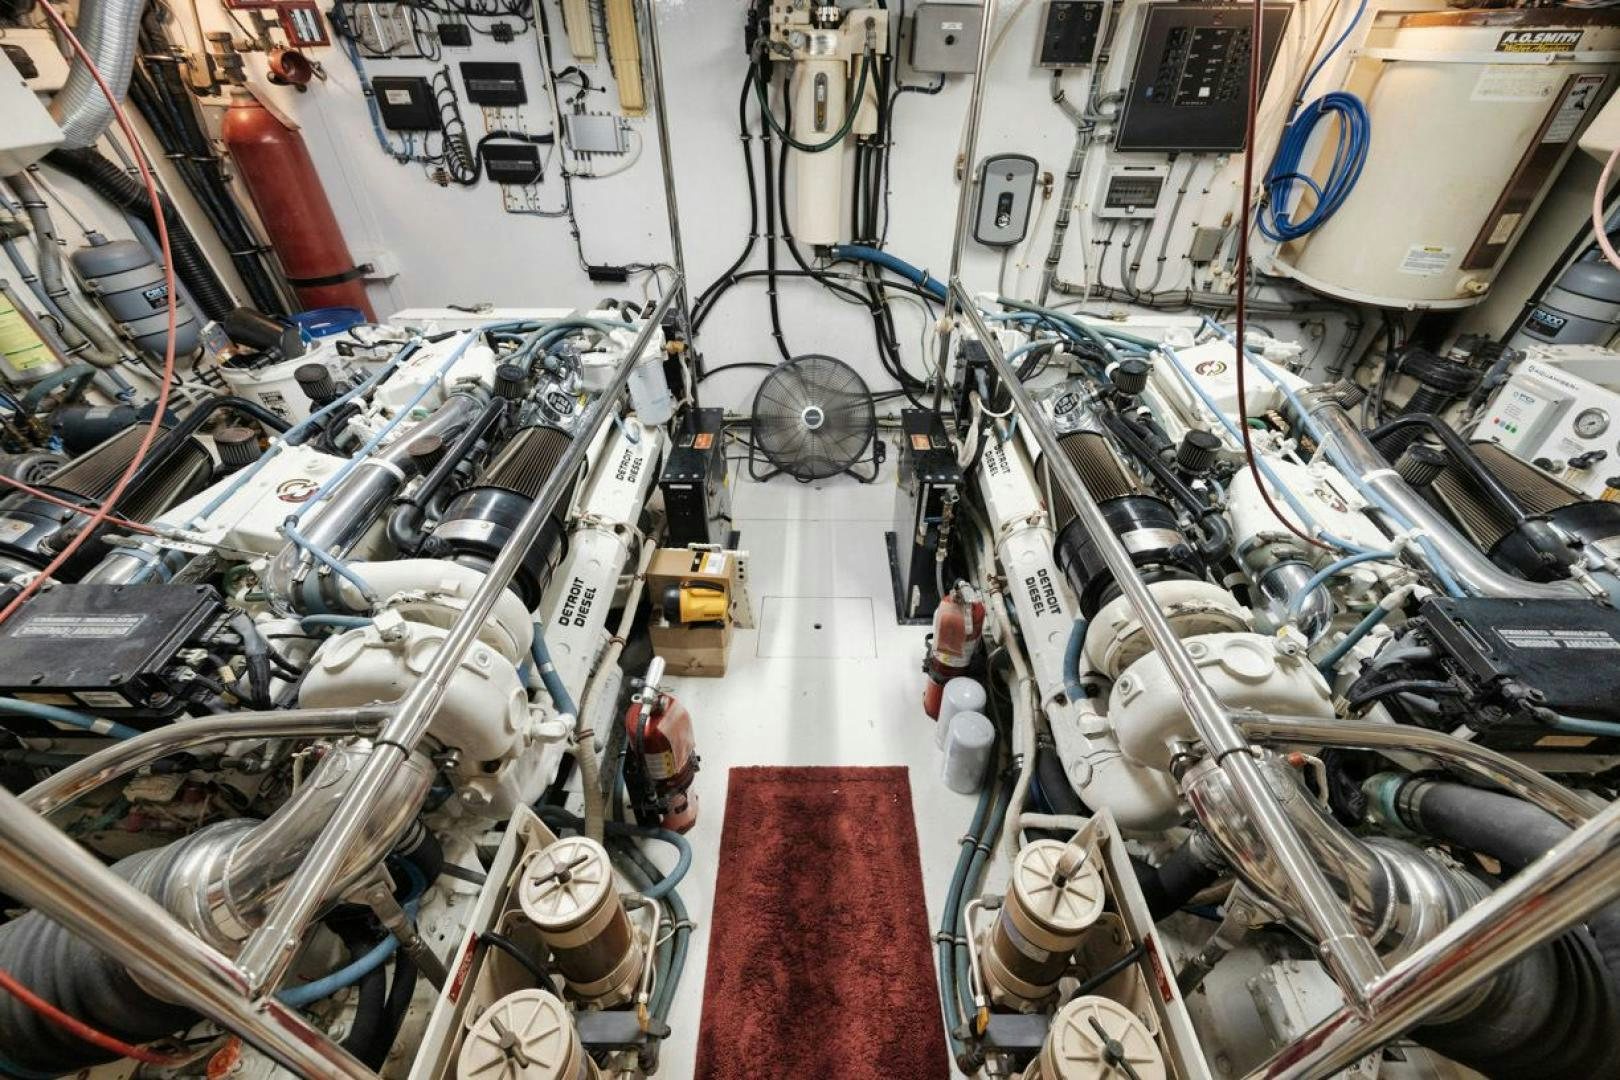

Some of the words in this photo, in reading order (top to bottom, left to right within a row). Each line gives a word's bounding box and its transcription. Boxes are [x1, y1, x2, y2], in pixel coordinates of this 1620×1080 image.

[615, 449, 633, 481] DETROIT
[627, 457, 643, 483] DIESEL
[558, 576, 585, 627] DETROIT
[573, 587, 597, 627] DIESEL
[1025, 576, 1046, 618] DIESEL
[1037, 568, 1062, 615] DETROIT
